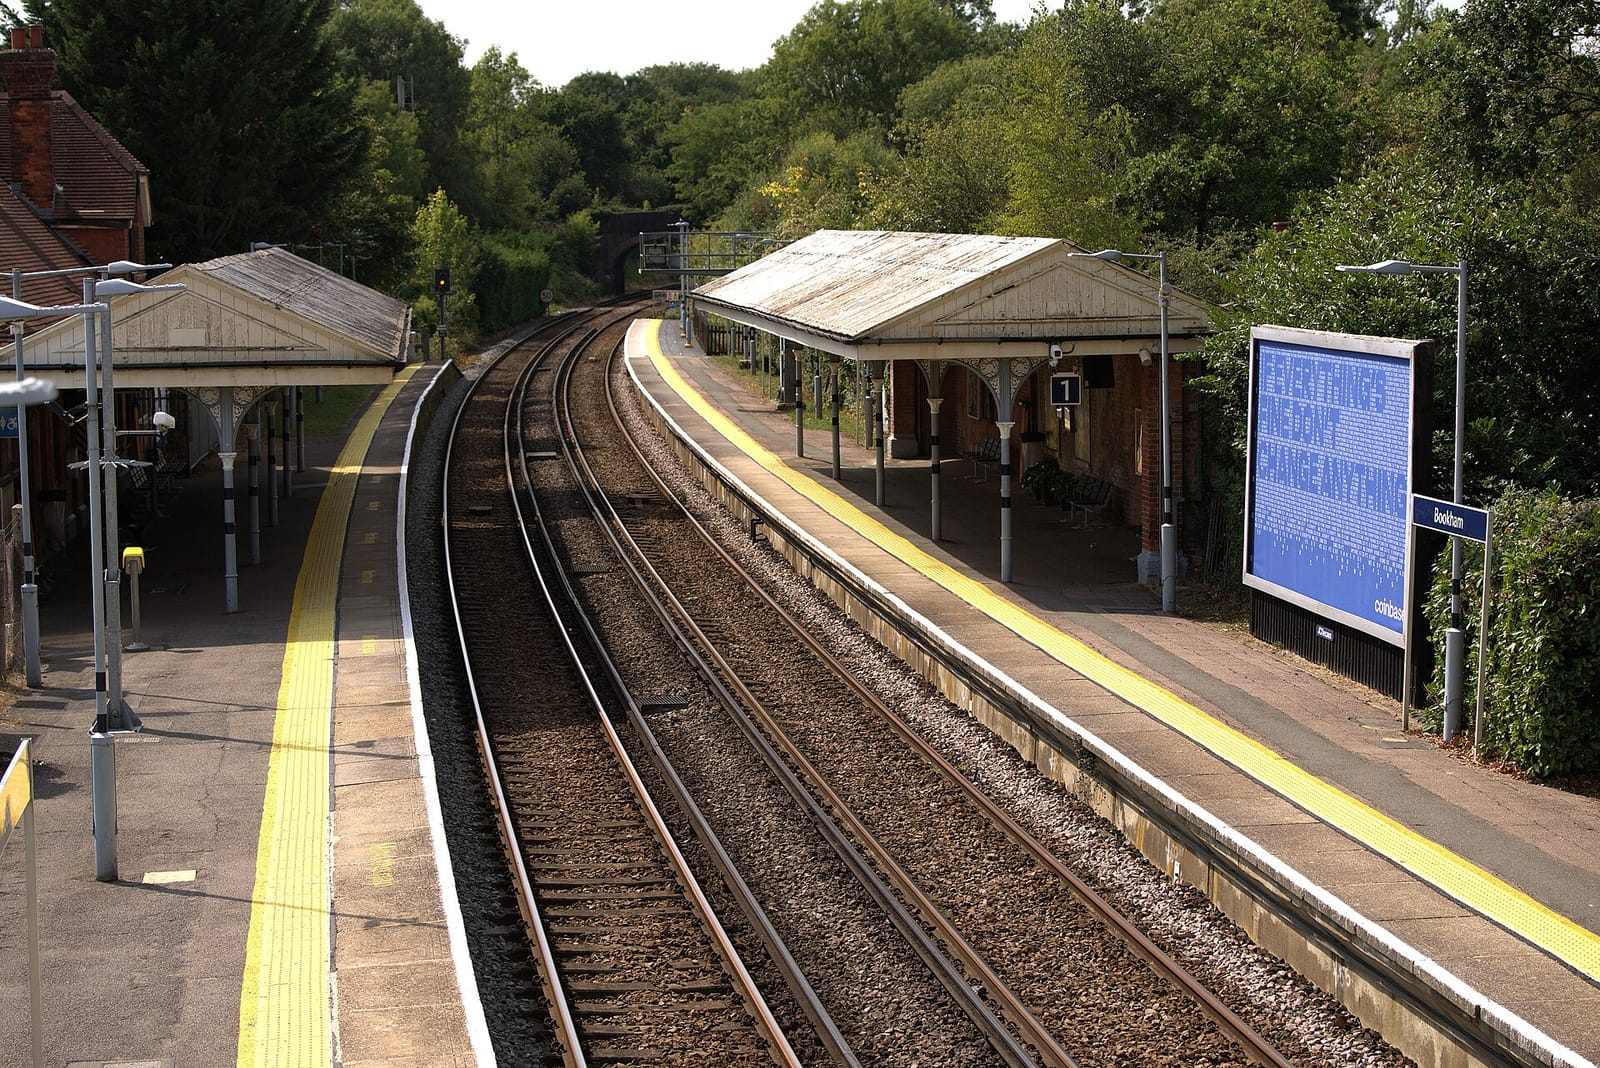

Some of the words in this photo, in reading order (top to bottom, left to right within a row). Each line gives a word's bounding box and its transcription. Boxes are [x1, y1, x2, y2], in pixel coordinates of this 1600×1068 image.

[1061, 379, 1069, 401] 1
[1260, 352, 1272, 392] IF
[1259, 394, 1289, 438] FINE
[1291, 400, 1339, 450] DON'T
[1258, 439, 1318, 494] CHANGE
[1320, 454, 1405, 519] ANYTHING
[1434, 507, 1464, 529] Bookham
